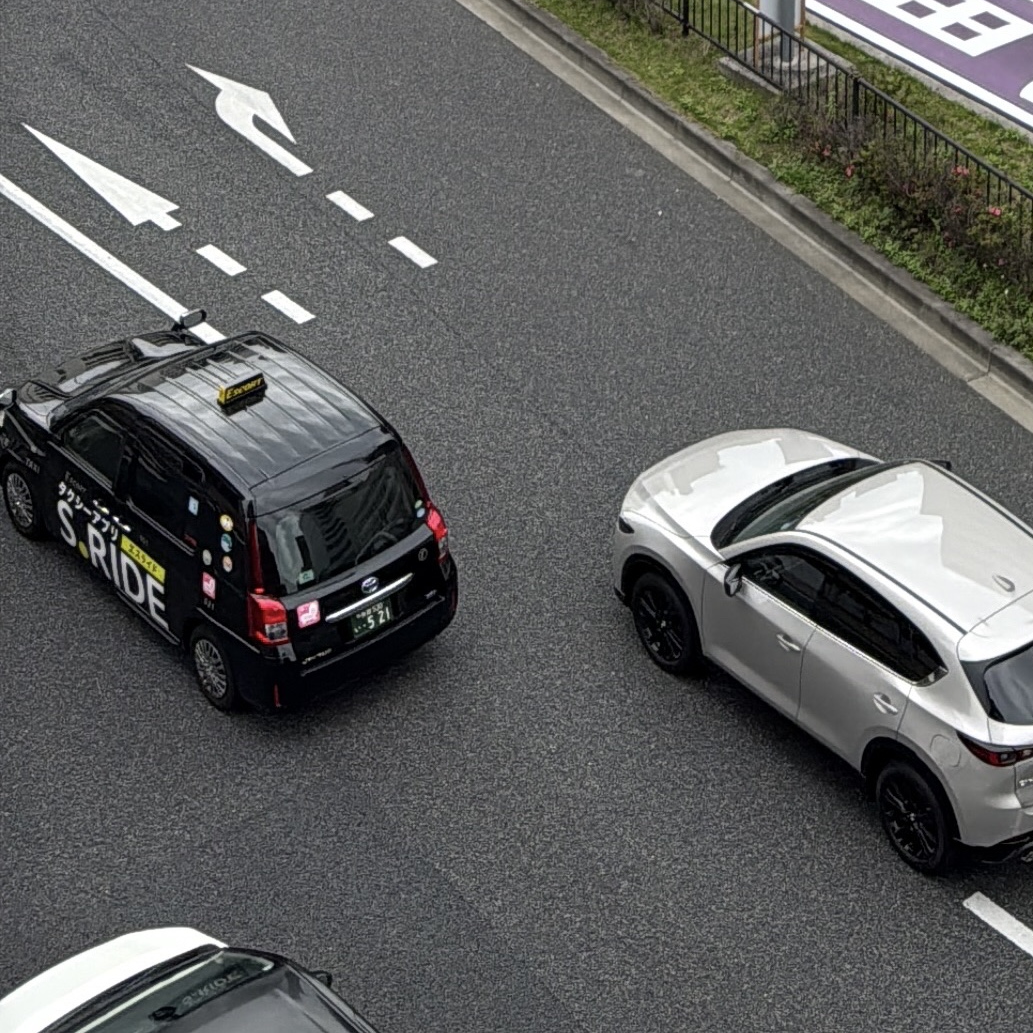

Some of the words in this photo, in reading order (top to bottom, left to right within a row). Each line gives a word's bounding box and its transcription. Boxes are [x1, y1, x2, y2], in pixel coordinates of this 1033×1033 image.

[58, 480, 119, 541] タクシーアプリ
[57, 499, 170, 632] S.RIDE
[126, 543, 160, 574] エスライド
